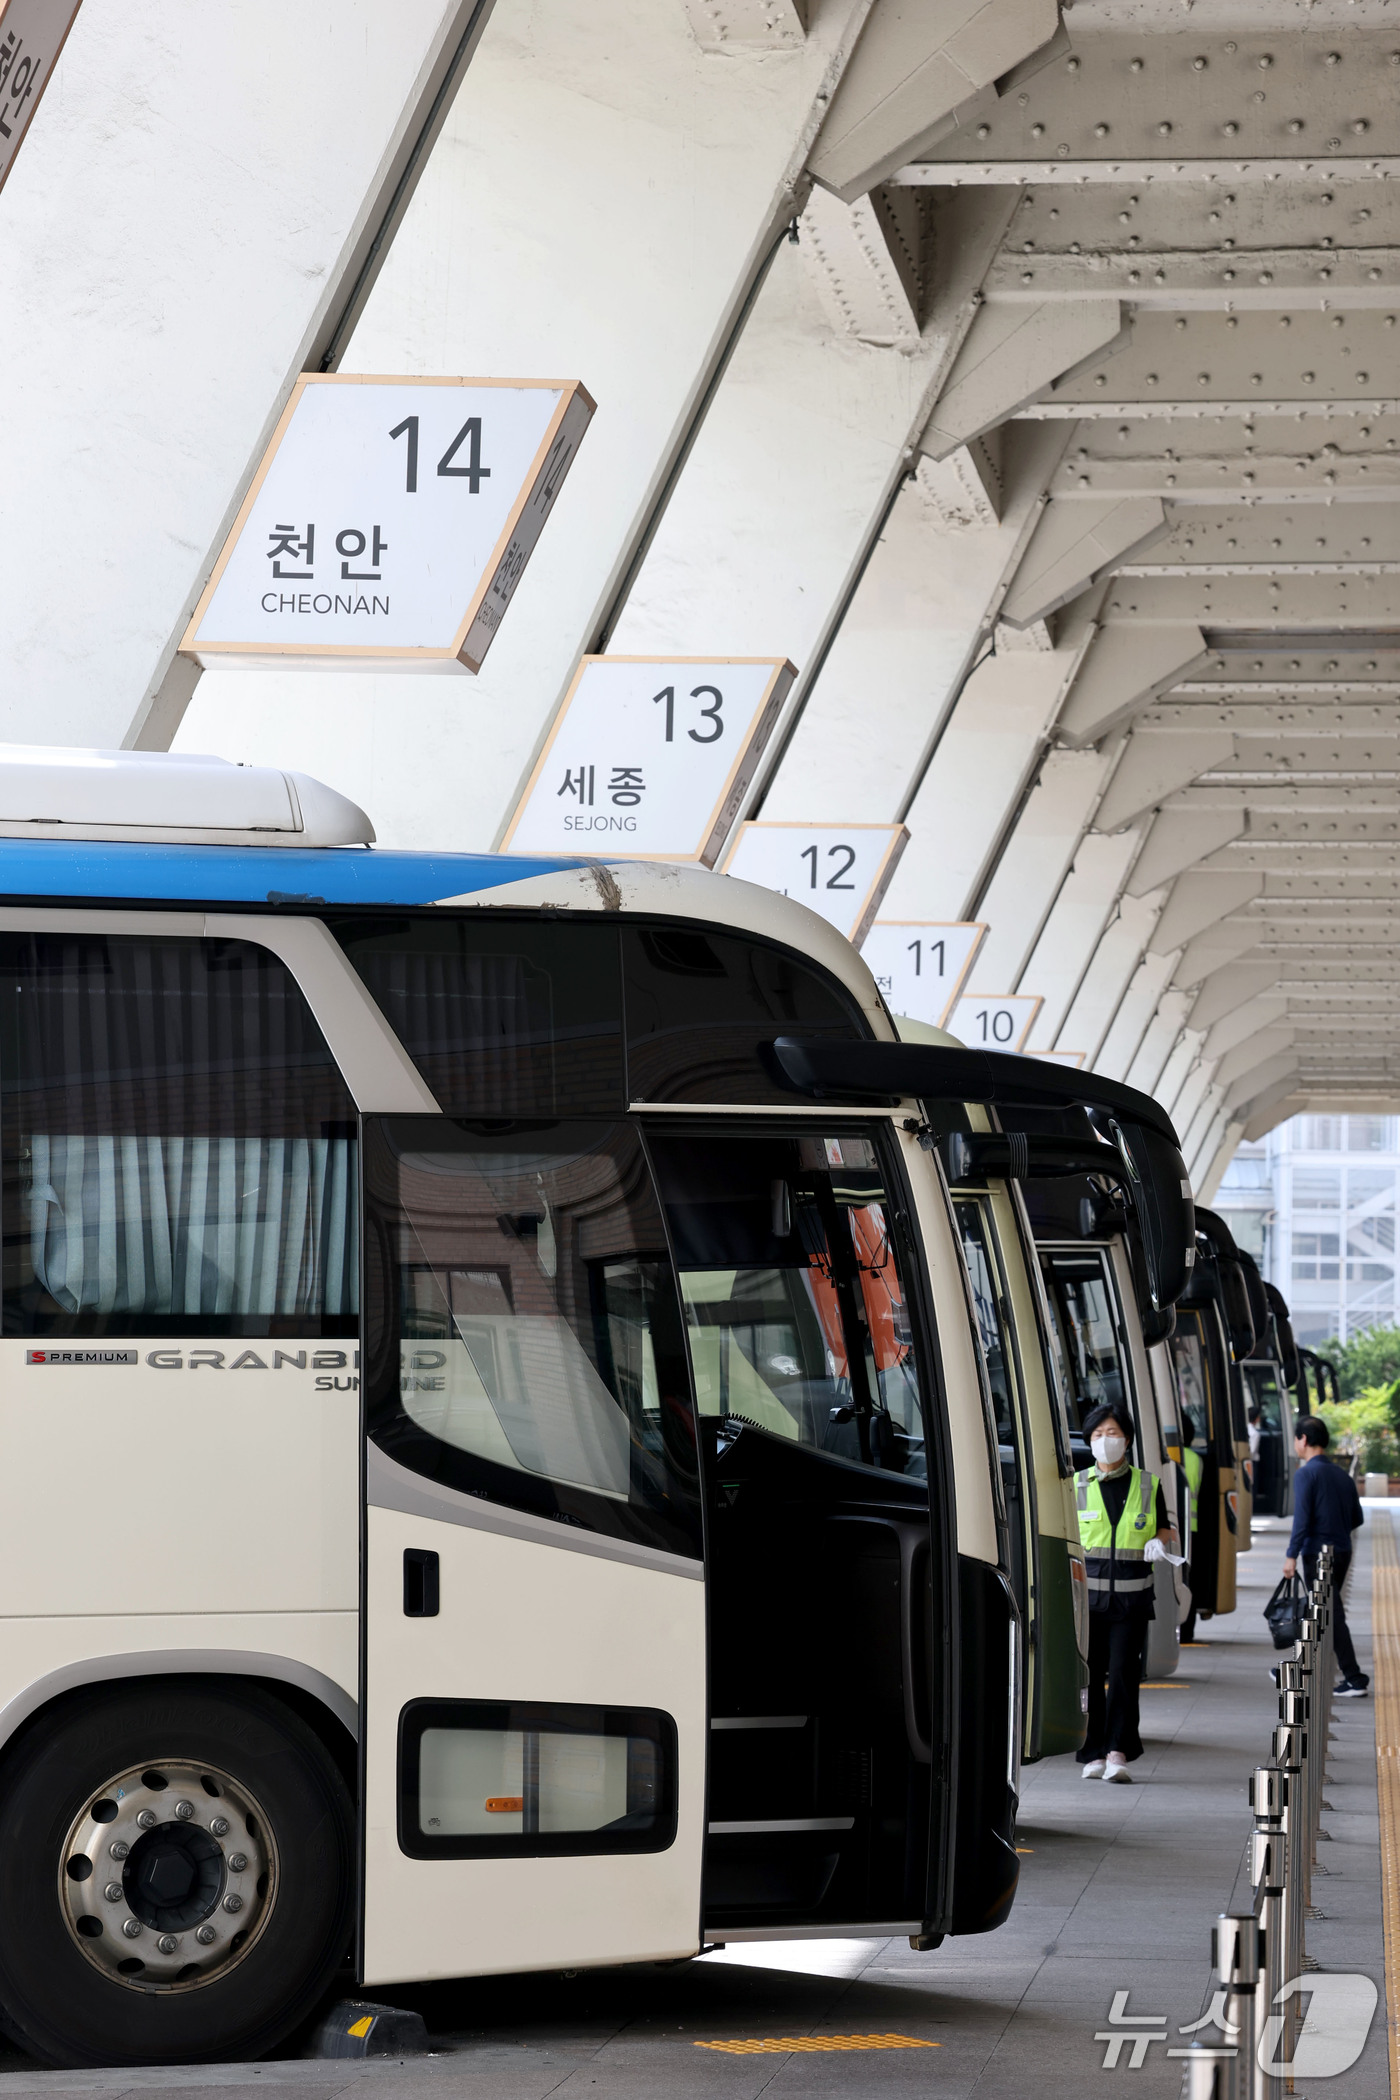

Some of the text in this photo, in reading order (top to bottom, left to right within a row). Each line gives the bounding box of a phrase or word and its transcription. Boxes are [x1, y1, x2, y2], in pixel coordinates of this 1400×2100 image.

[388, 415, 491, 494] 14
[533, 434, 572, 514] 14
[266, 523, 388, 581] 천안
[493, 541, 527, 601] 천안
[261, 592, 390, 616] CHEONAN
[652, 685, 724, 744] 13
[556, 764, 646, 807] 세종
[563, 815, 637, 832] SEJONG
[800, 844, 856, 890] 12
[906, 939, 945, 977] 11
[975, 1010, 1014, 1042] 10
[50, 1353, 129, 1362] PREMIUM
[145, 1348, 447, 1370] GRANBID
[314, 1375, 446, 1392] SUINE
